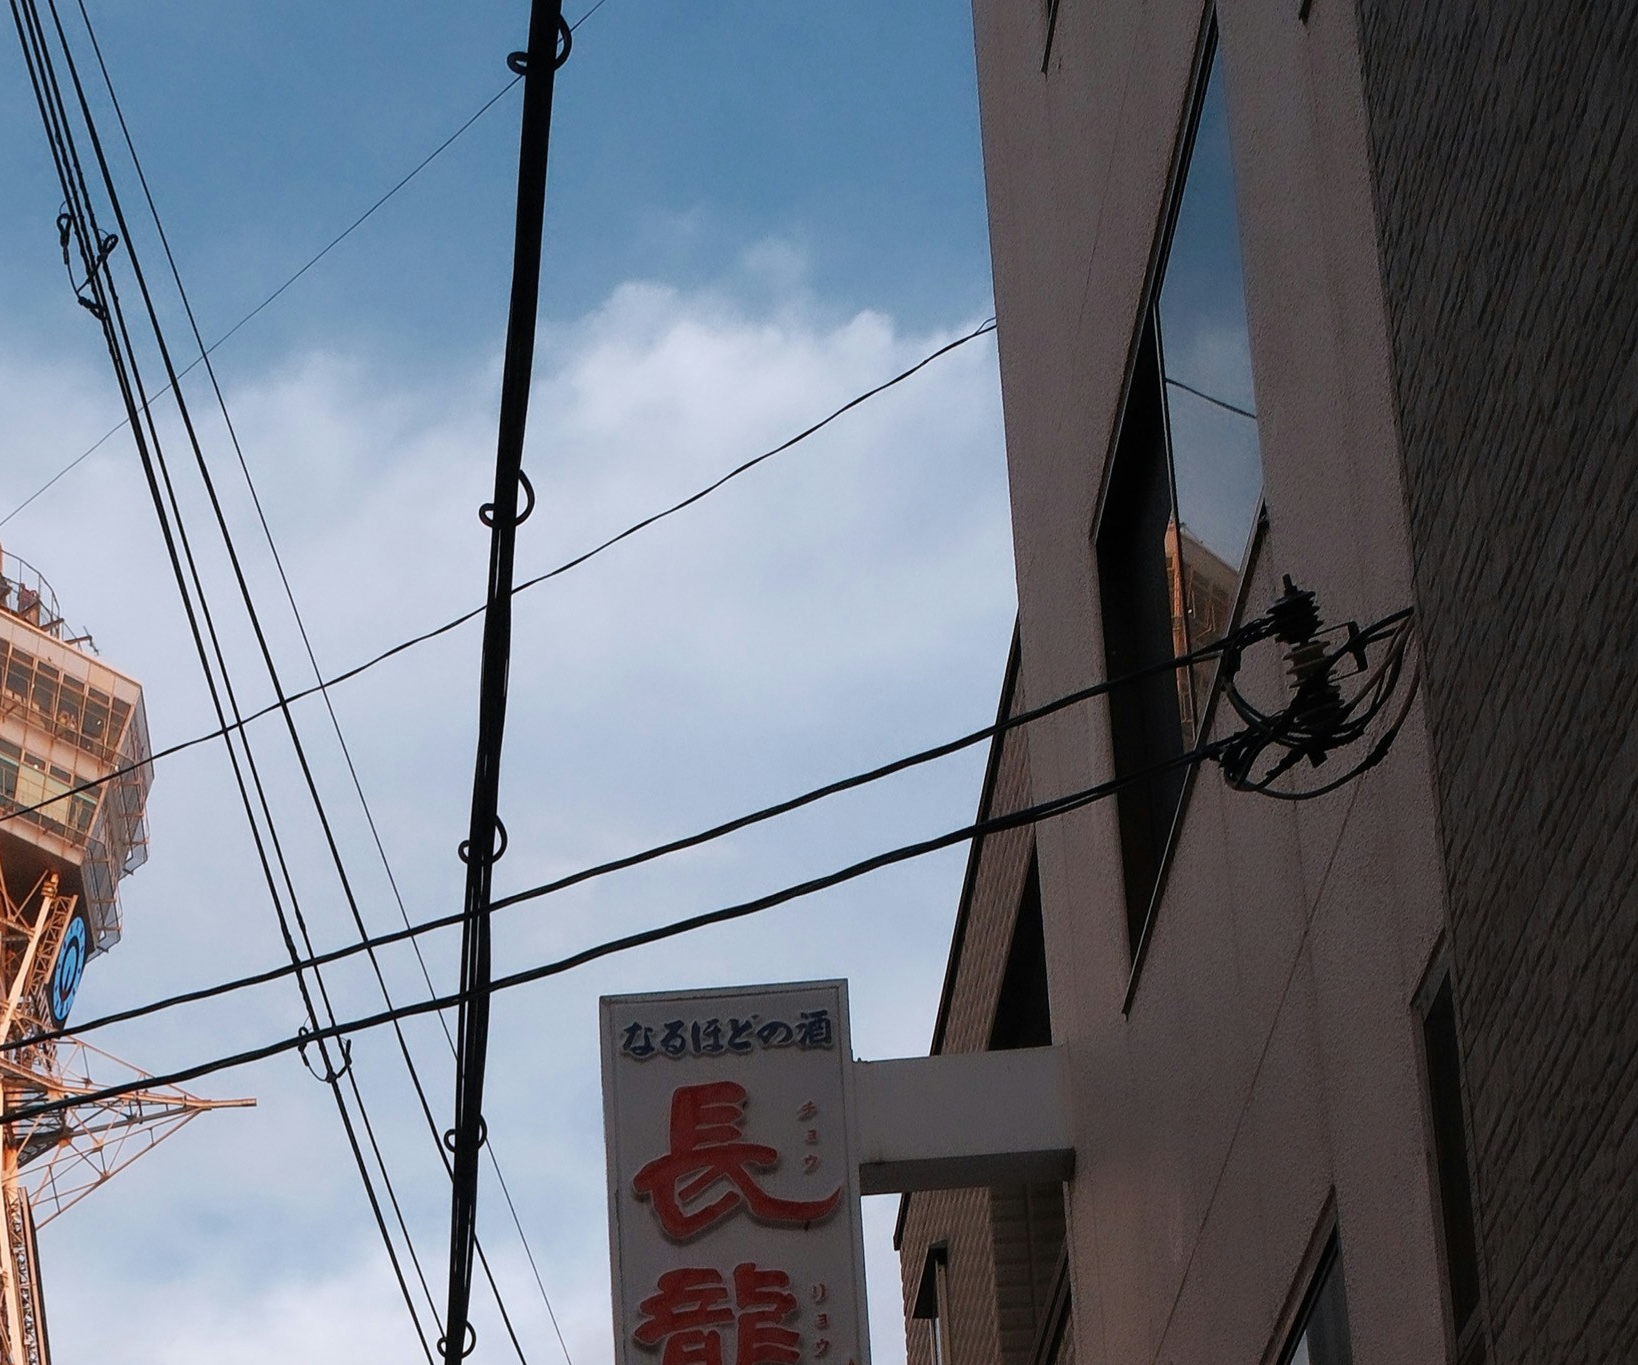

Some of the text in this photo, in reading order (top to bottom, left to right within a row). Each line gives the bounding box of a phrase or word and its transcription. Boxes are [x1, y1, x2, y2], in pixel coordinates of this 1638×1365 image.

[622, 1010, 833, 1055] なるほどの酒
[797, 1100, 821, 1173] チョウ
[812, 1283, 830, 1357] リョウ
